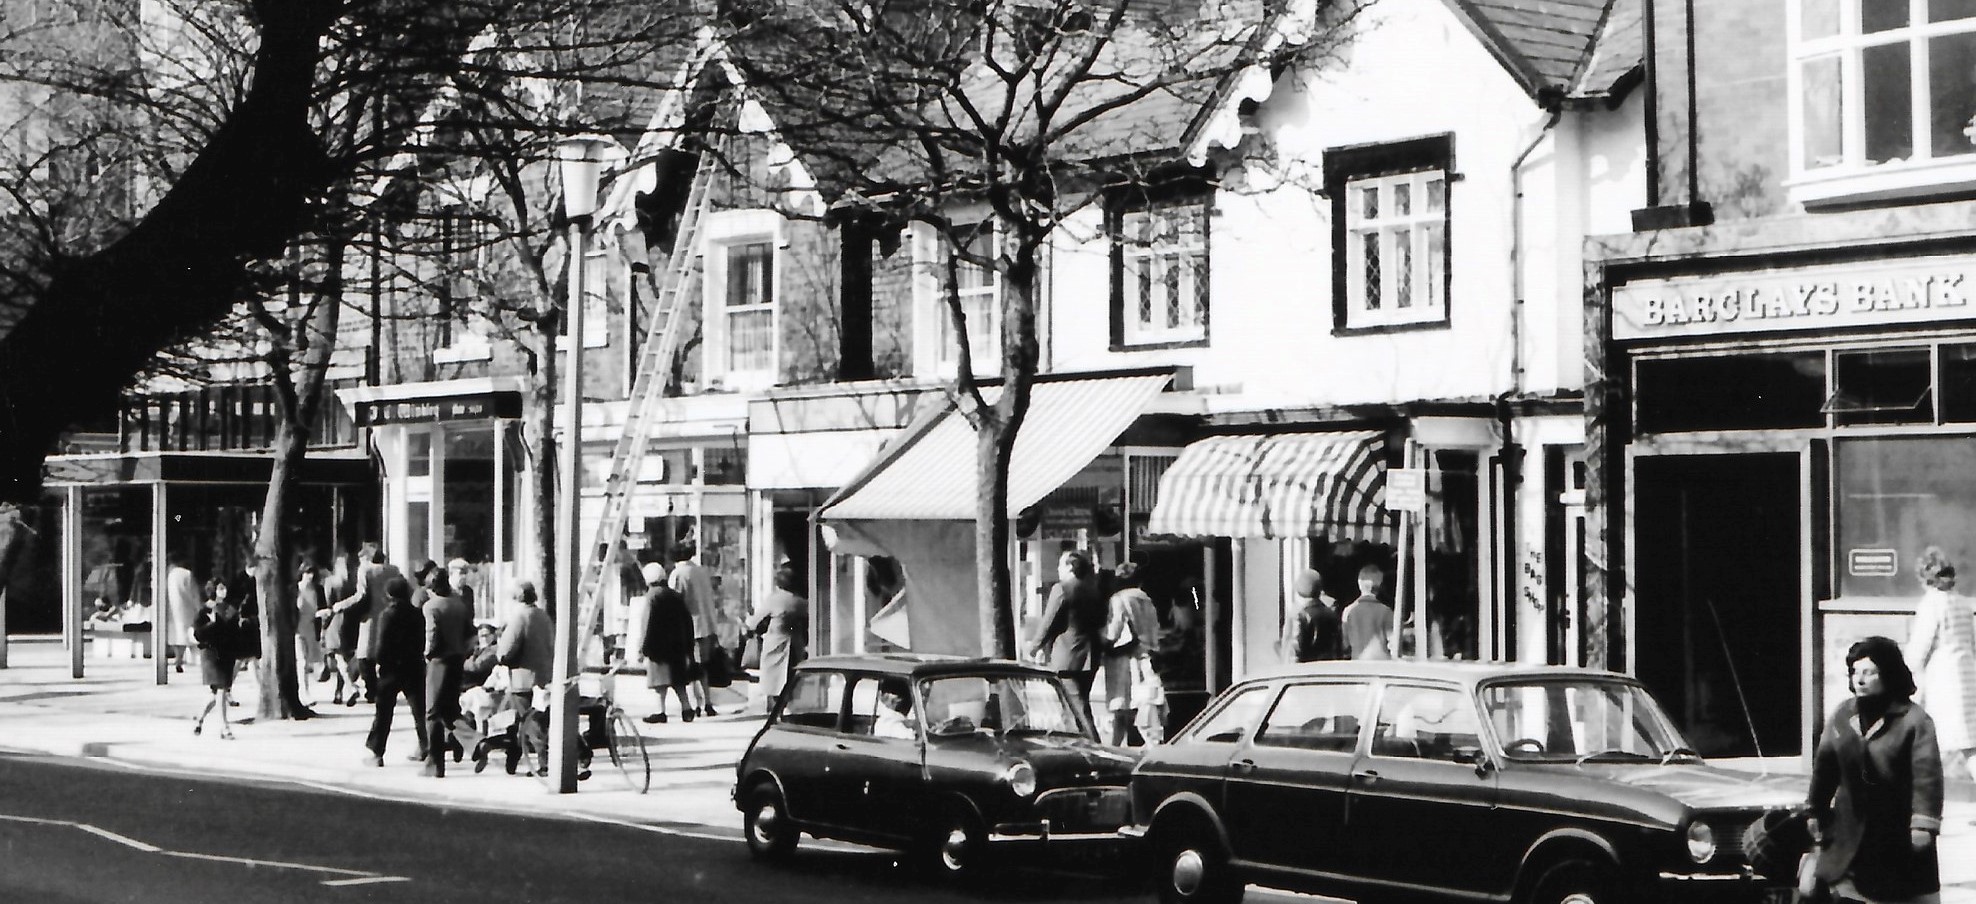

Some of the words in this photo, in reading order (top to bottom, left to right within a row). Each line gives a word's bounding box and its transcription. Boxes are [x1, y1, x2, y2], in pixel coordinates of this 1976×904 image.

[1643, 282, 1840, 326] BARCLAYS
[1852, 274, 1967, 313] BANK
[1524, 563, 1542, 585] BAG
